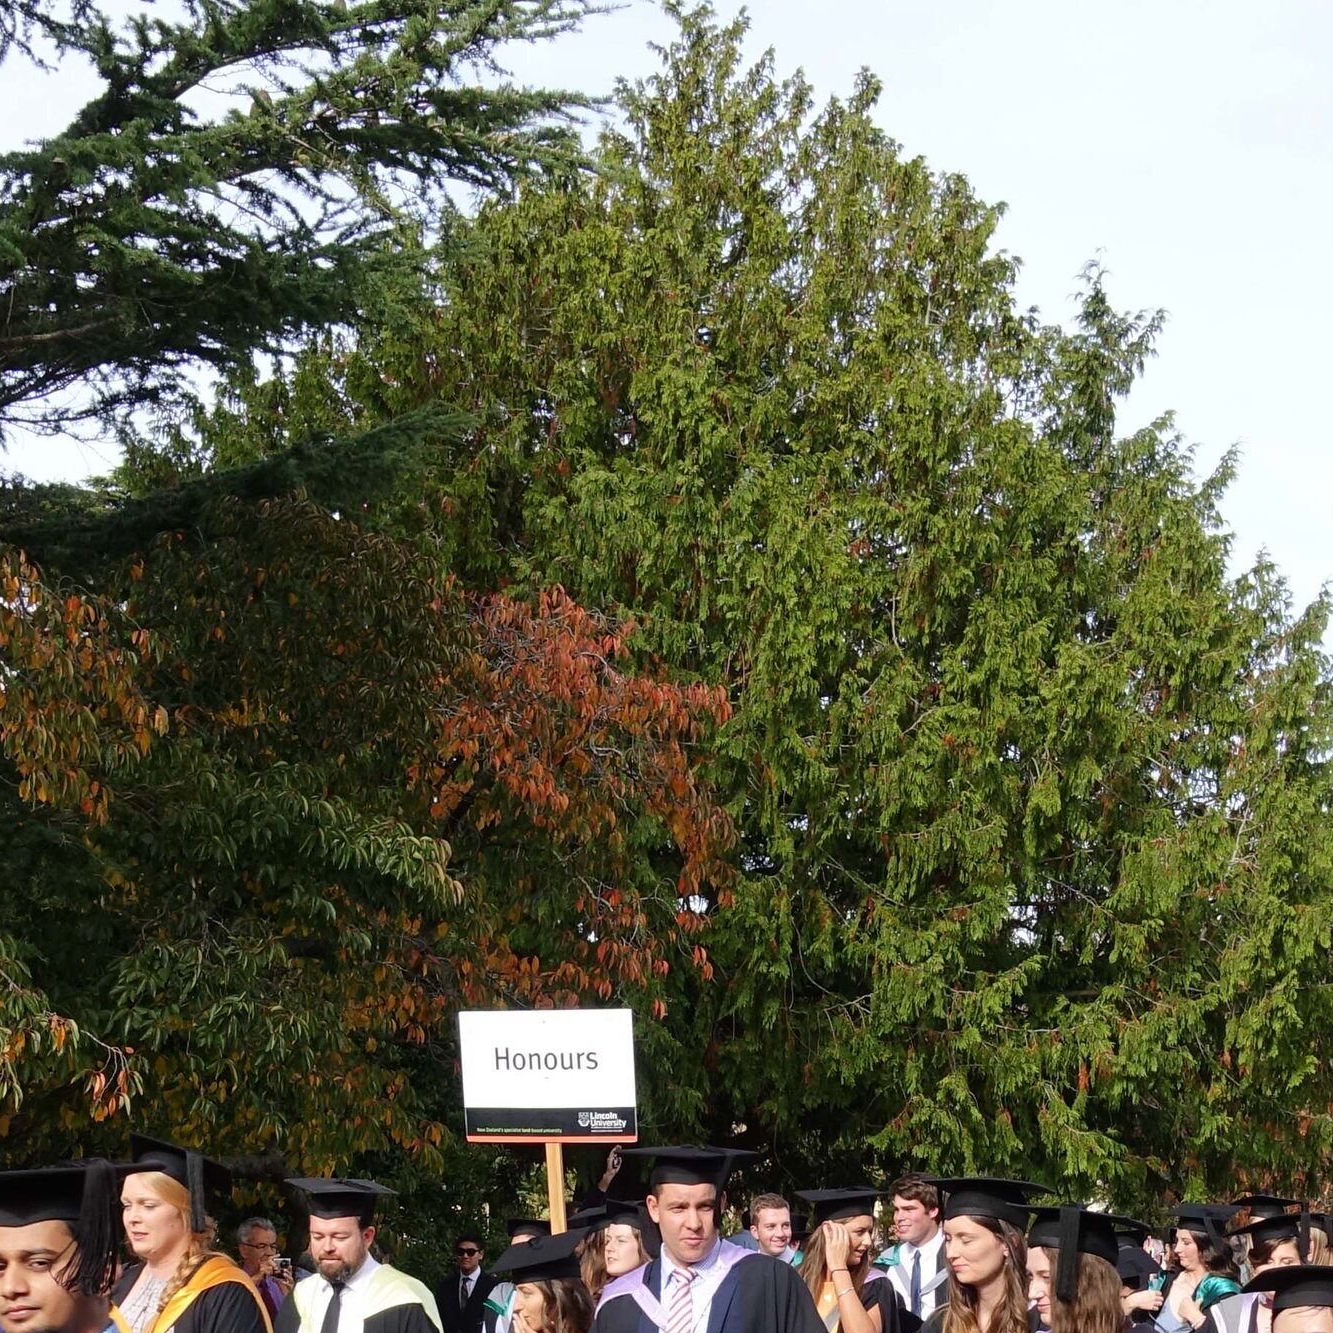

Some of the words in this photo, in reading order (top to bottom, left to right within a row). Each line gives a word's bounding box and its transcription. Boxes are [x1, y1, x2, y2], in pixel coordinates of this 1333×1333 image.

[495, 1047, 599, 1070] Honours
[589, 1111, 618, 1120] Lincoln
[590, 1119, 627, 1128] University
